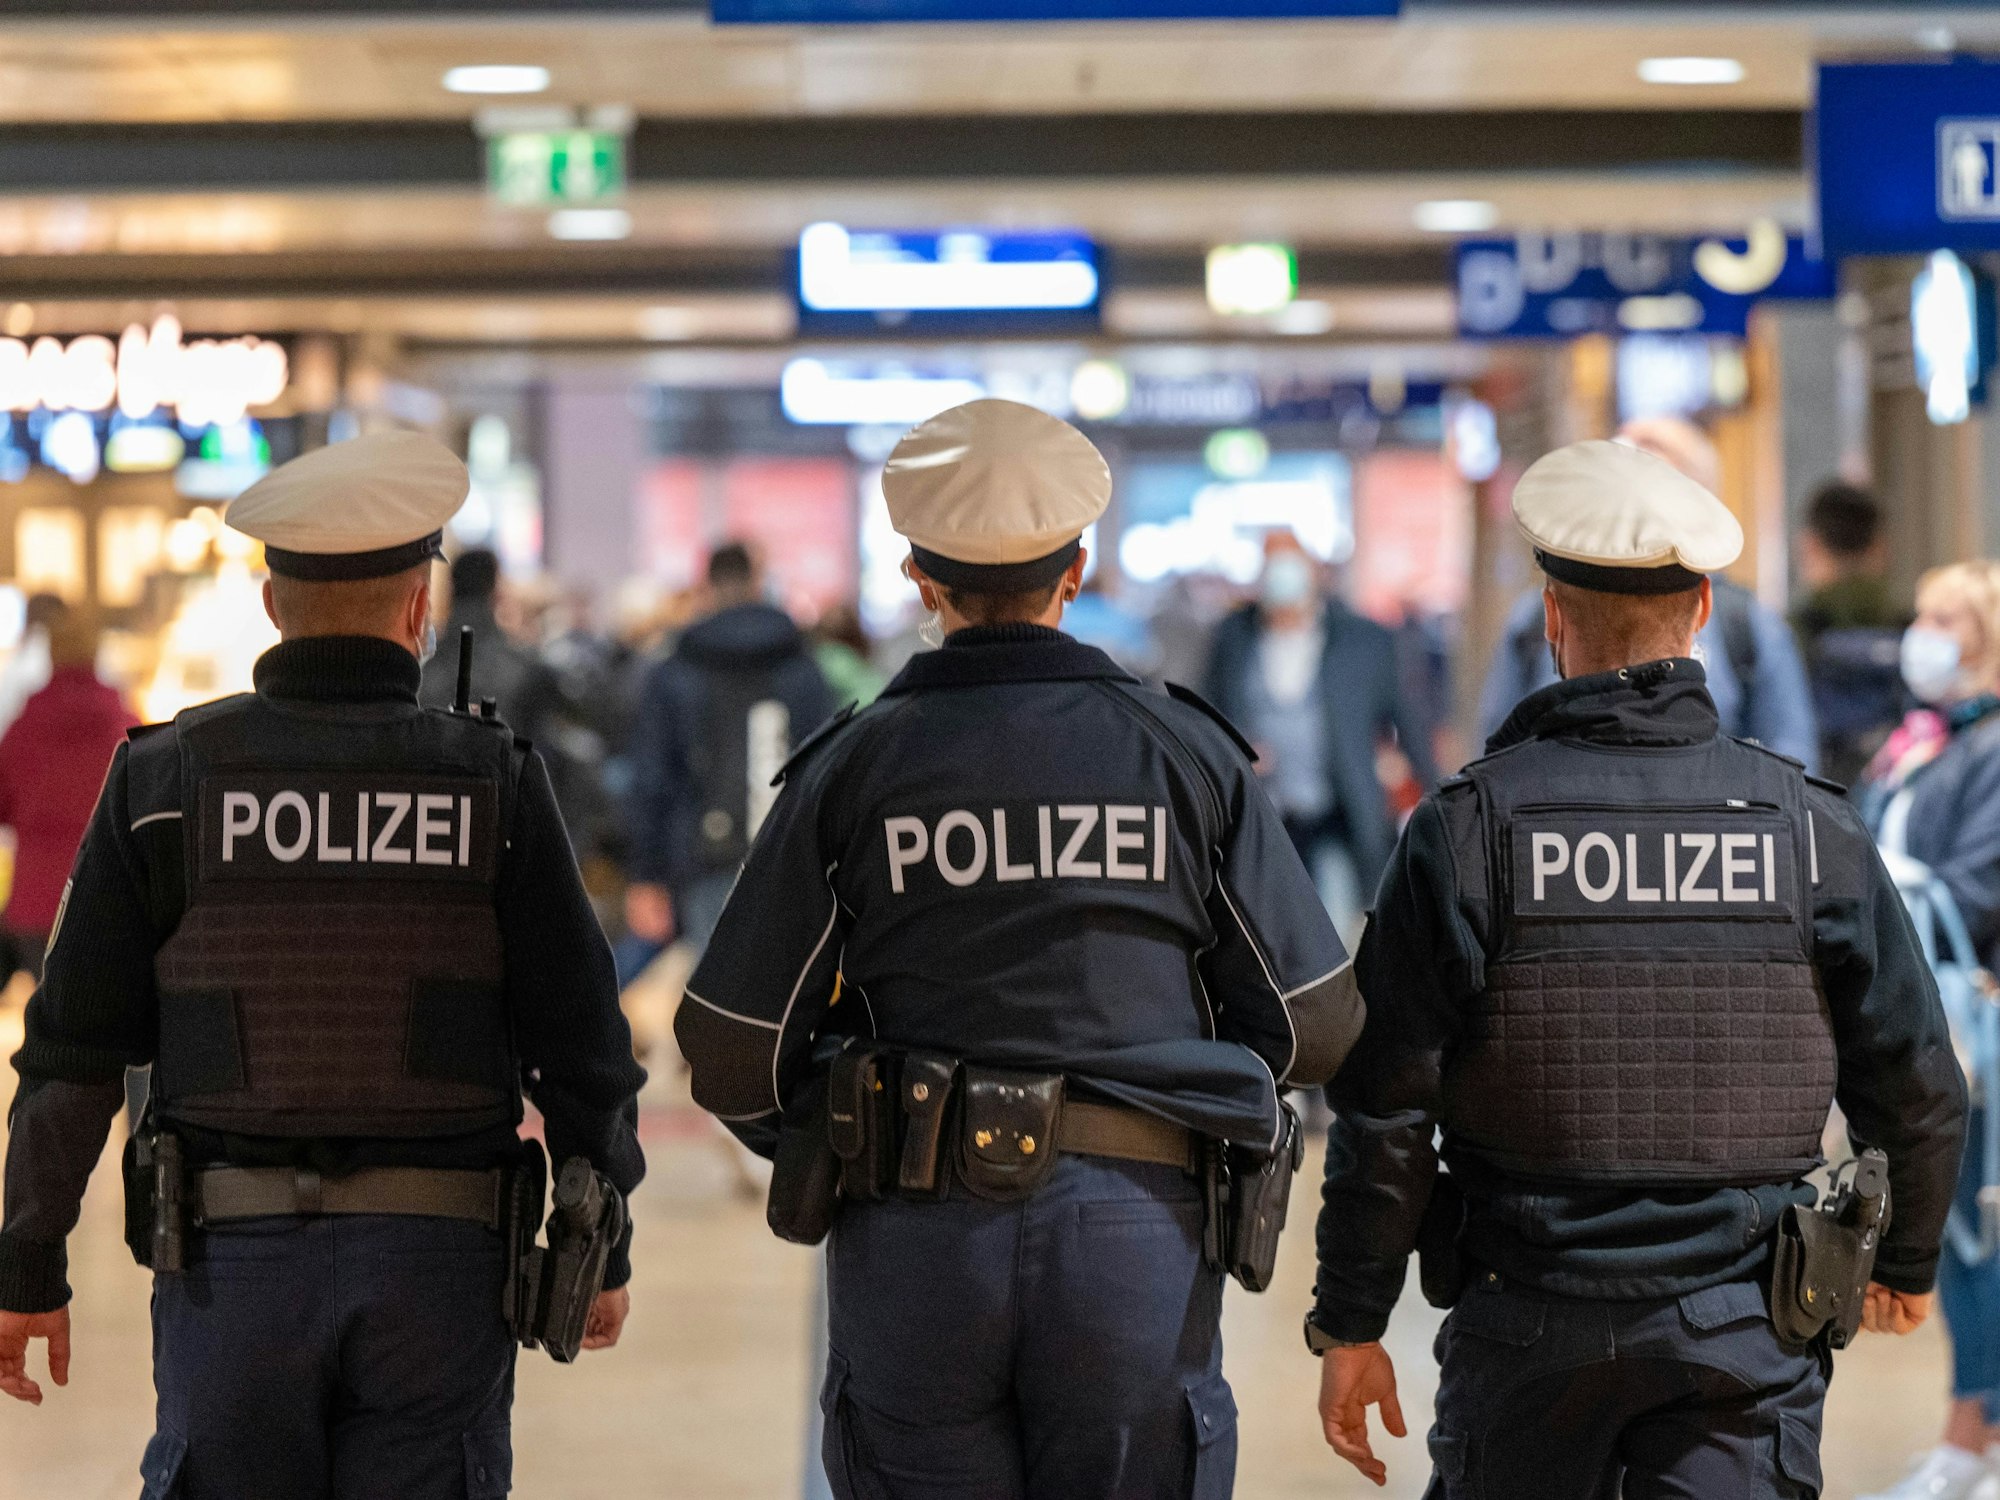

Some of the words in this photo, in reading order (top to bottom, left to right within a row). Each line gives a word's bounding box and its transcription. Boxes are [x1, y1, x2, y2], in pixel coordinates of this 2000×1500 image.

[222, 791, 472, 867] POLIZEI
[884, 804, 1168, 893] POLIZEI
[1531, 831, 1777, 903] POLIZEI
